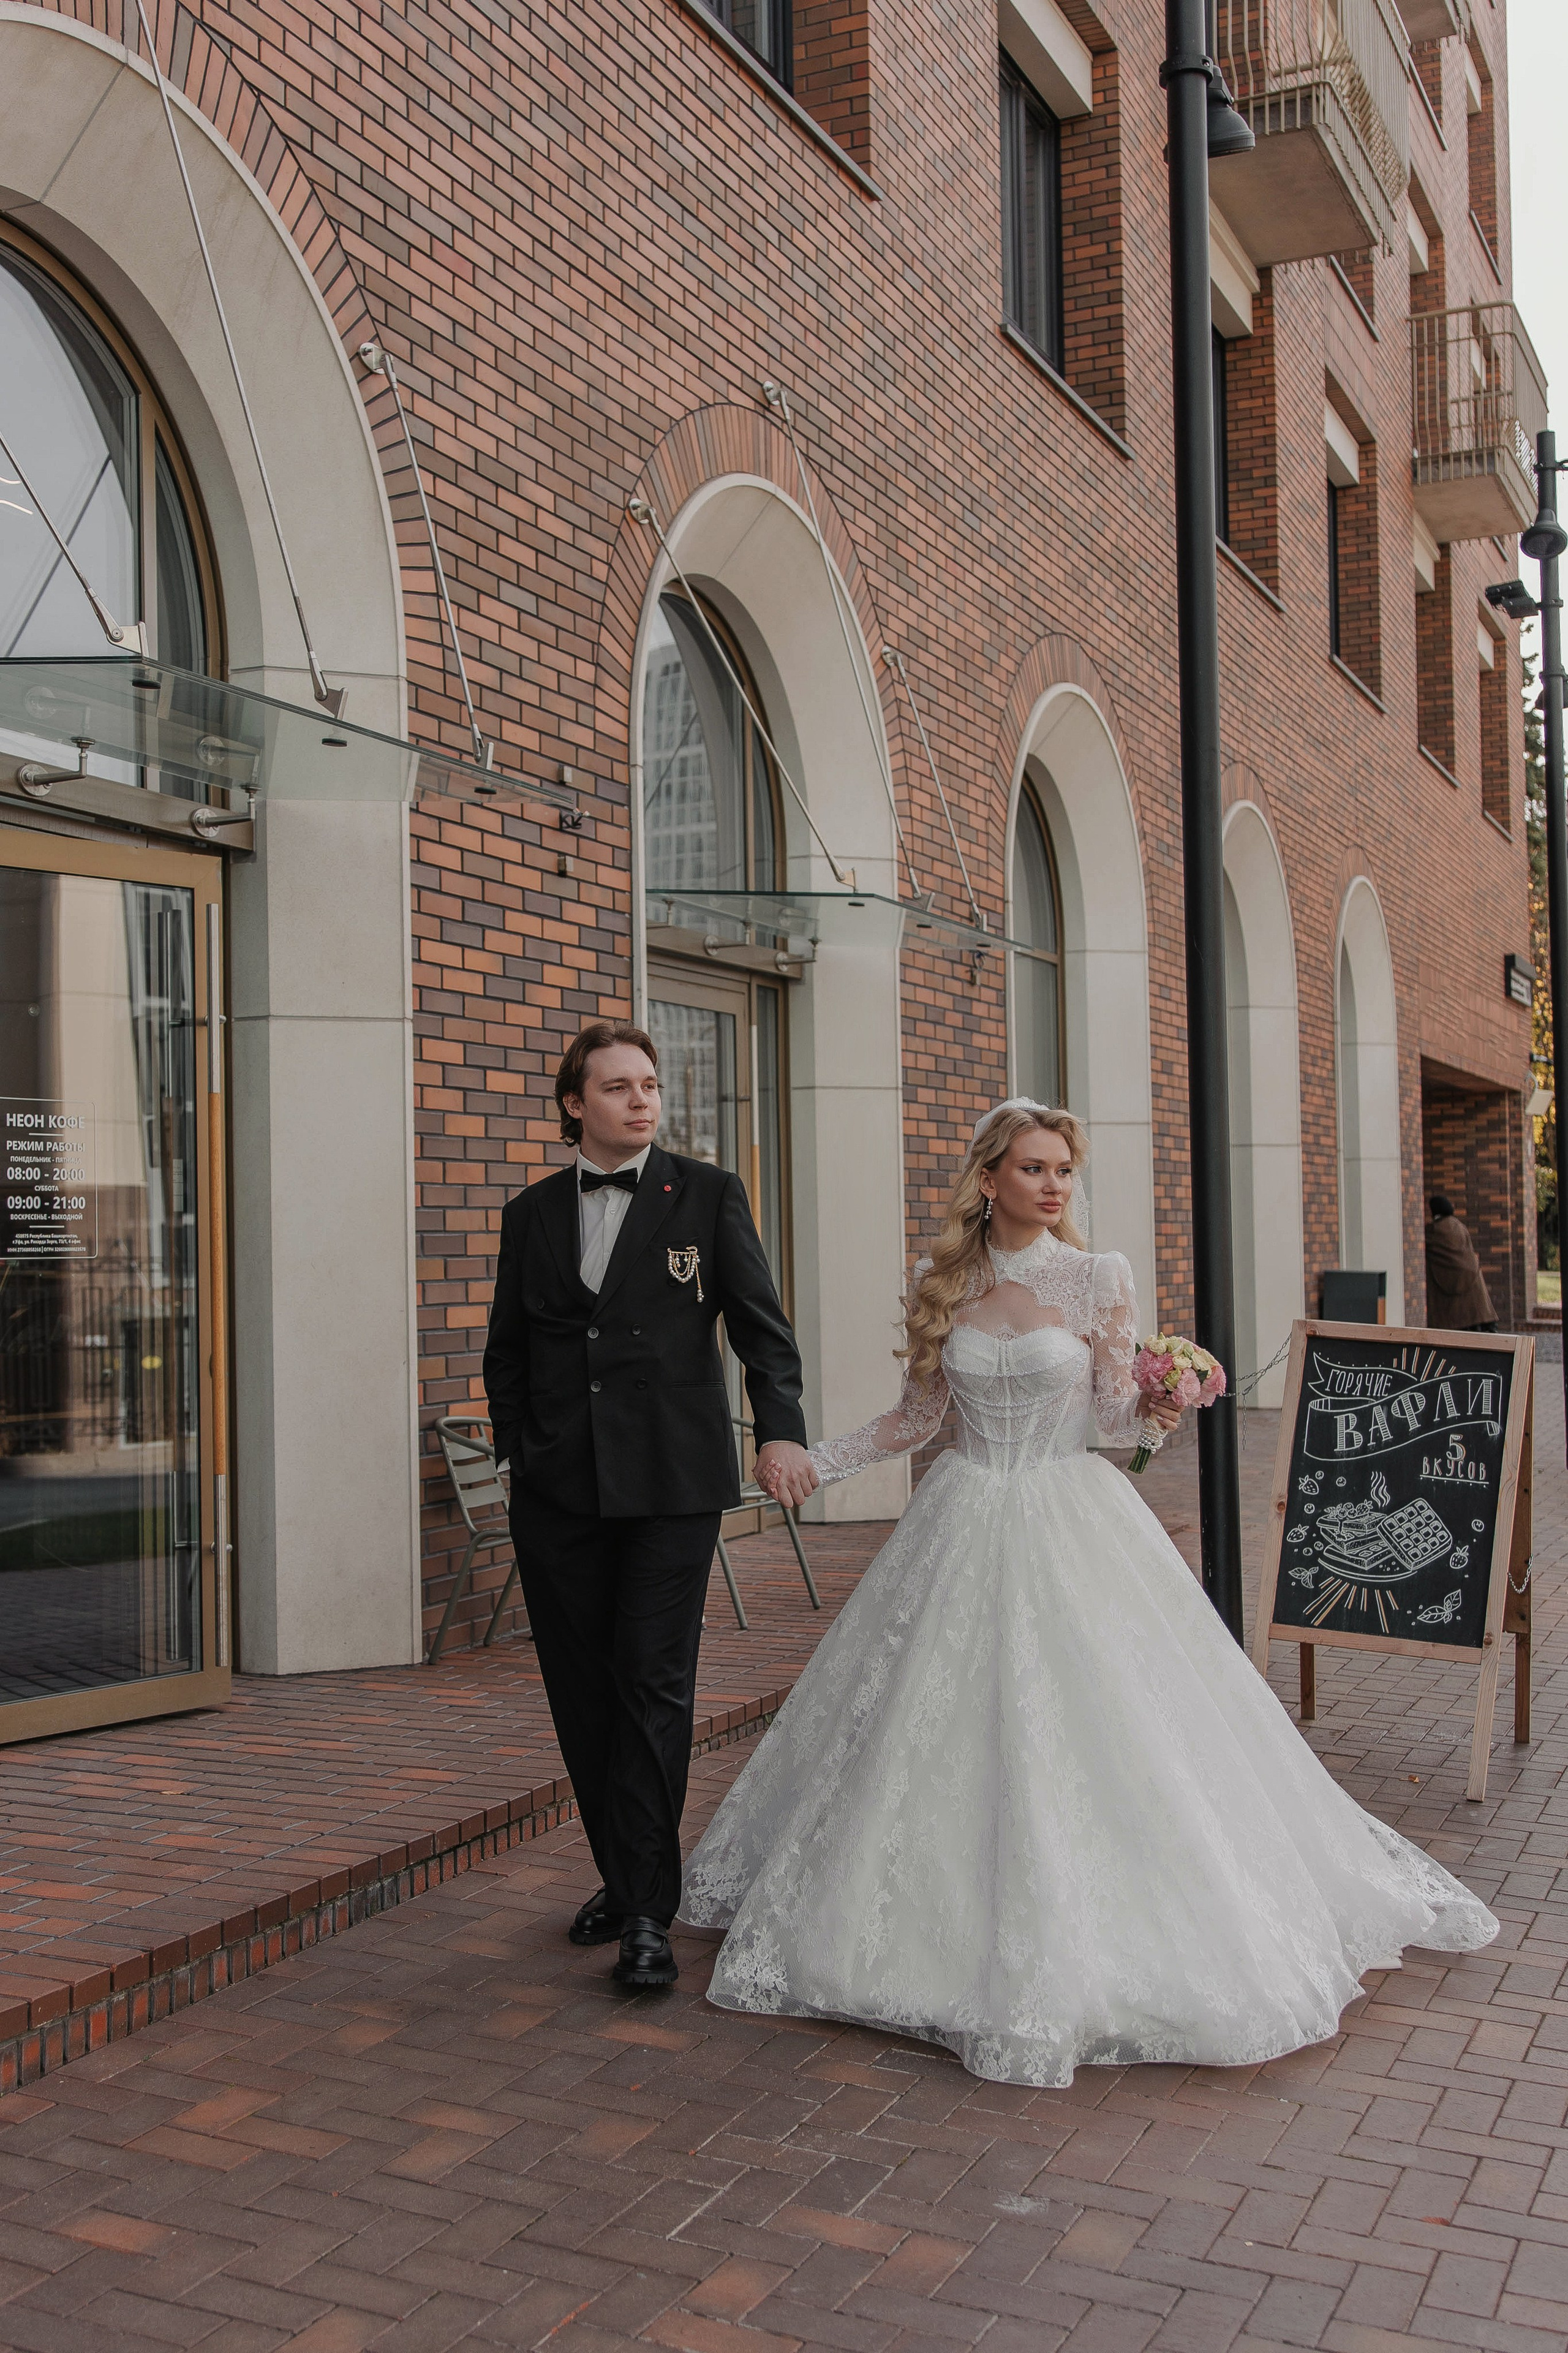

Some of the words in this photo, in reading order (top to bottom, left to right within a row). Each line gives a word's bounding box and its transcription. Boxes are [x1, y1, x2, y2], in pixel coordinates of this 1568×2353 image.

[6, 1113, 45, 1128] НЕОН
[48, 1114, 86, 1128] КОФЕ
[6, 1140, 44, 1151] РЕЖИМ
[46, 1141, 85, 1152] РАБОТЫ
[7, 1166, 41, 1180] 08:00
[53, 1167, 85, 1181] 20:00
[7, 1196, 41, 1210] 09:00
[53, 1196, 86, 1210] 21:00
[51, 1212, 83, 1221] ВЫХОДНОЙ
[1325, 1369, 1393, 1397] ГОРЯЧИЕ
[1334, 1378, 1493, 1452] ВАФЛИ
[1446, 1433, 1466, 1462] 5
[1422, 1456, 1487, 1481] ВКУСОВ
